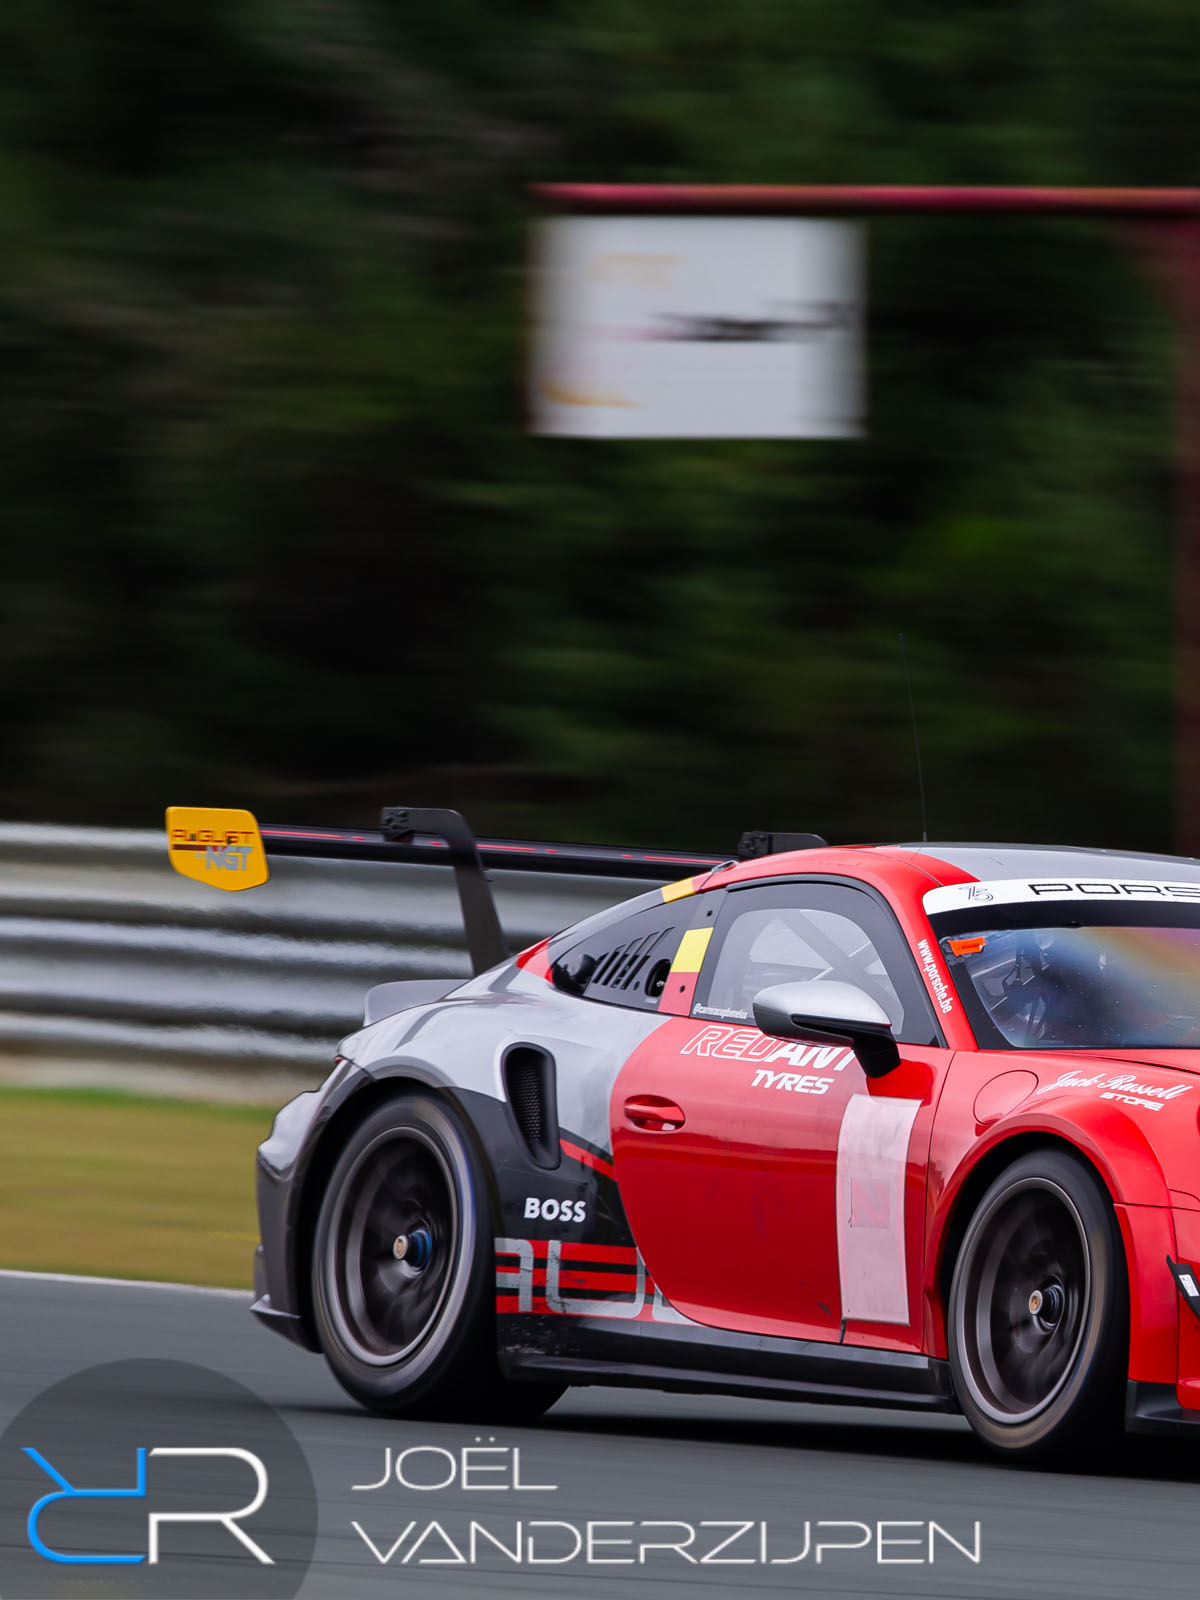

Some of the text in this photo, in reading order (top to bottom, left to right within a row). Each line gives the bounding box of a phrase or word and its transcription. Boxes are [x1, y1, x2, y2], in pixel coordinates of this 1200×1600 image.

[916, 938, 954, 1015] www.porsche.be
[751, 1069, 836, 1095] TYRES
[1036, 1070, 1194, 1101] Jack Russell
[1098, 1091, 1165, 1112] STORE
[523, 1197, 588, 1224] BOSS
